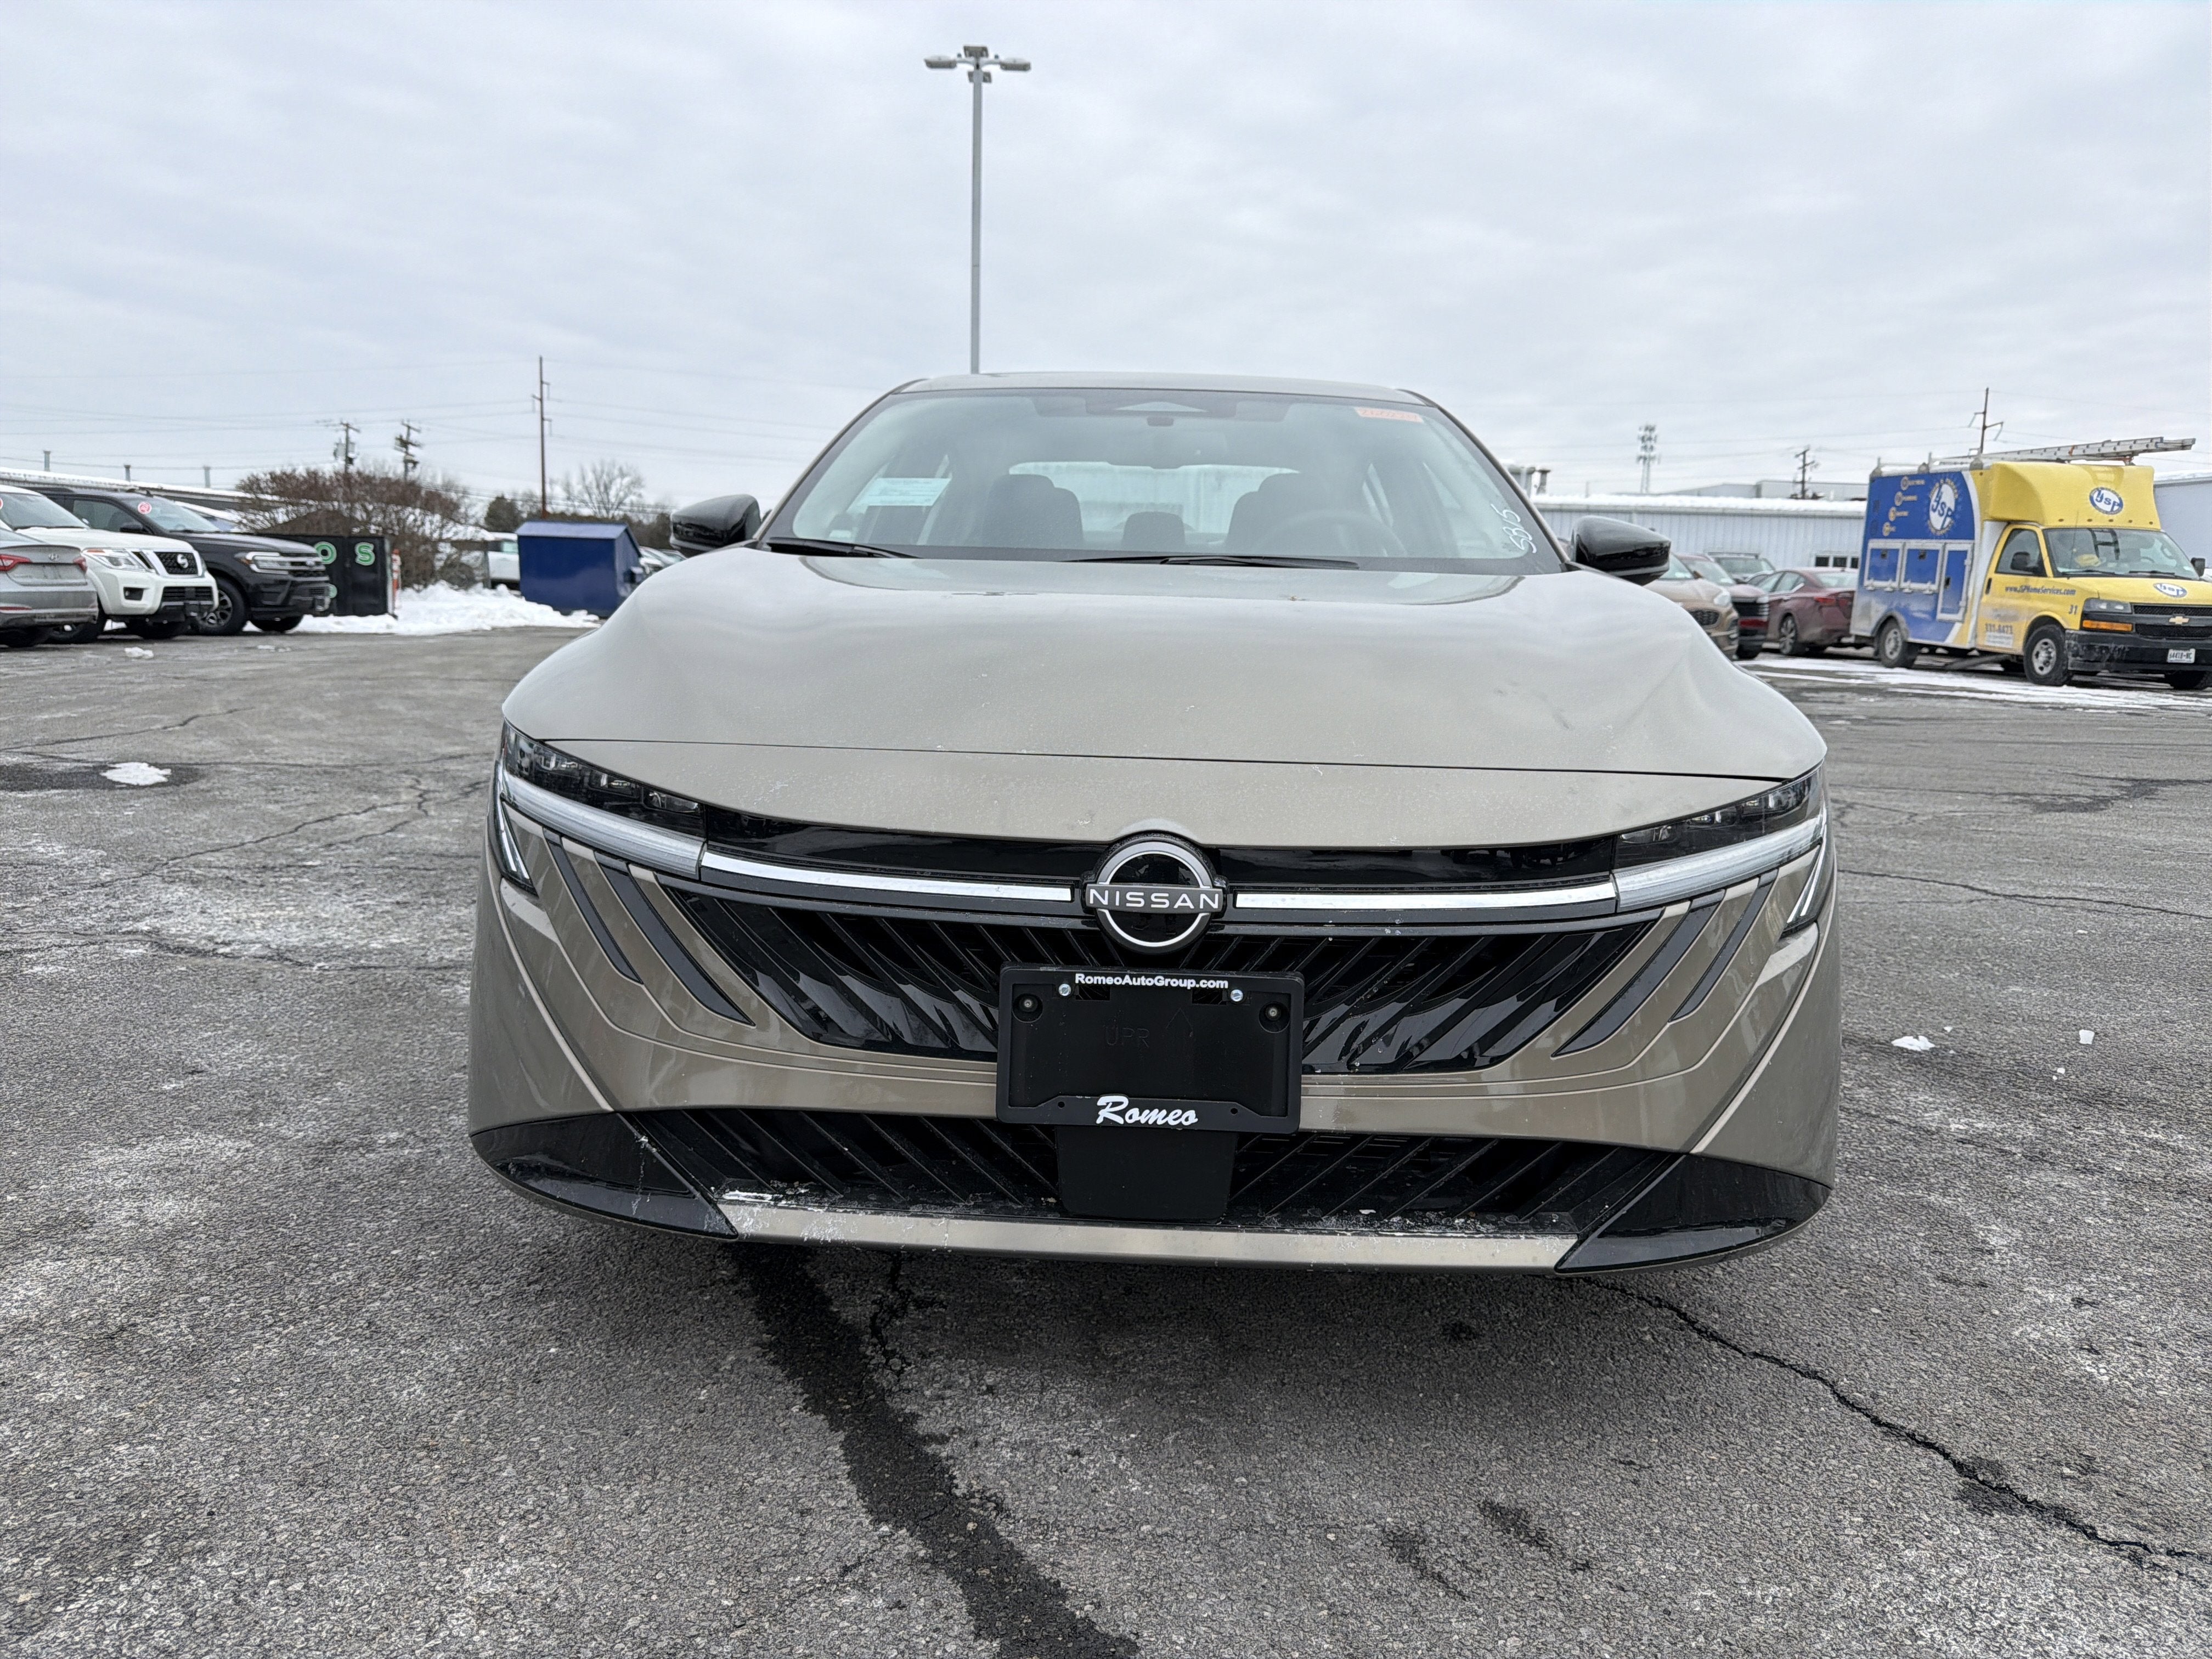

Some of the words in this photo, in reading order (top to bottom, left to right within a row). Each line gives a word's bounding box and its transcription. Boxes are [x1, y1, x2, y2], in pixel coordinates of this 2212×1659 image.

[2069, 605, 2078, 614] 31
[1090, 889, 1219, 909] NISSAN
[1075, 973, 1228, 989] RomeoAutoGroup.com
[1105, 1026, 1149, 1048] UPR
[1096, 1096, 1198, 1125] Romeo
